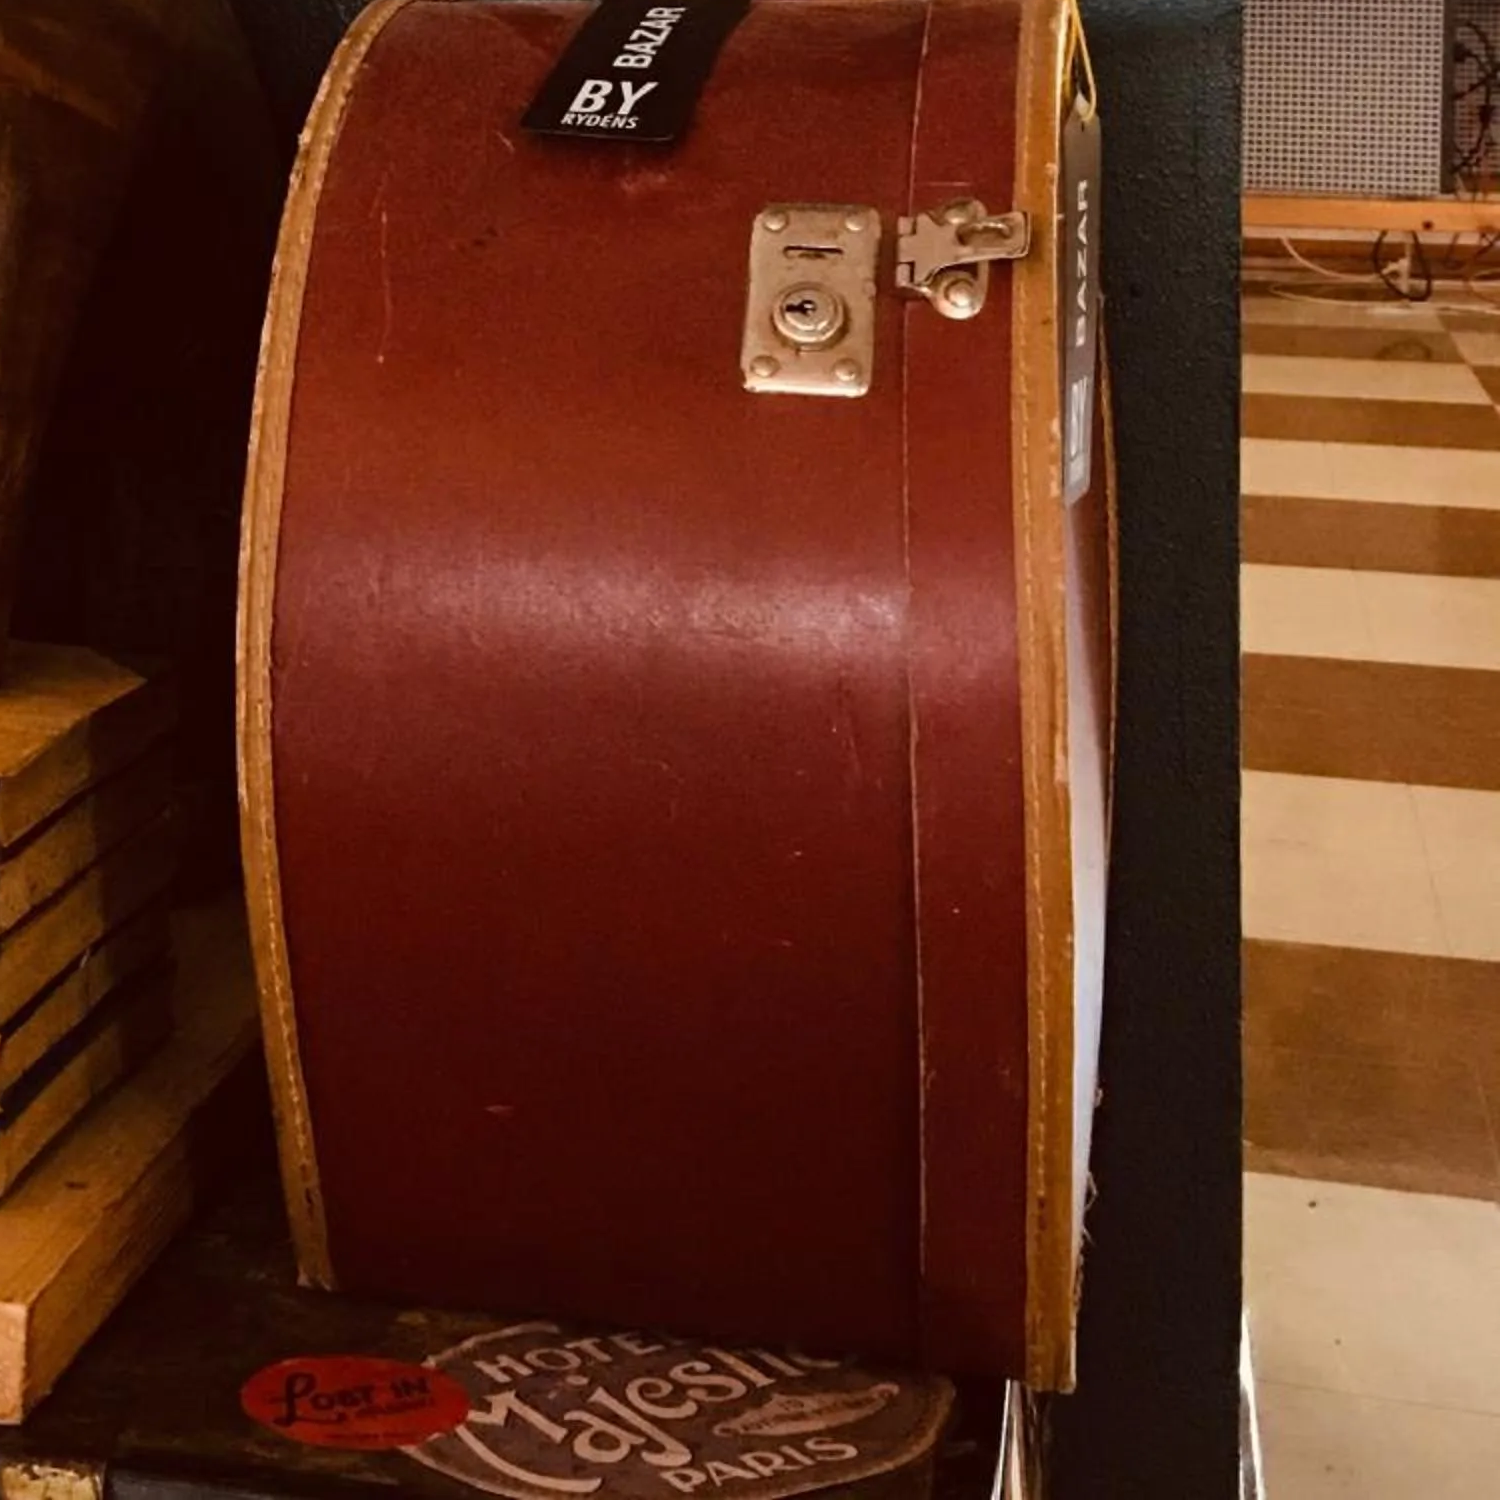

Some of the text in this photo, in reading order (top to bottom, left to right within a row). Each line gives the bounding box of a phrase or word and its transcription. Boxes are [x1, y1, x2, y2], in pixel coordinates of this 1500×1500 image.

[612, 6, 686, 69] BAZAR
[568, 79, 660, 115] BY
[473, 1331, 688, 1383] HOTE
[659, 1436, 858, 1493] PARIS
